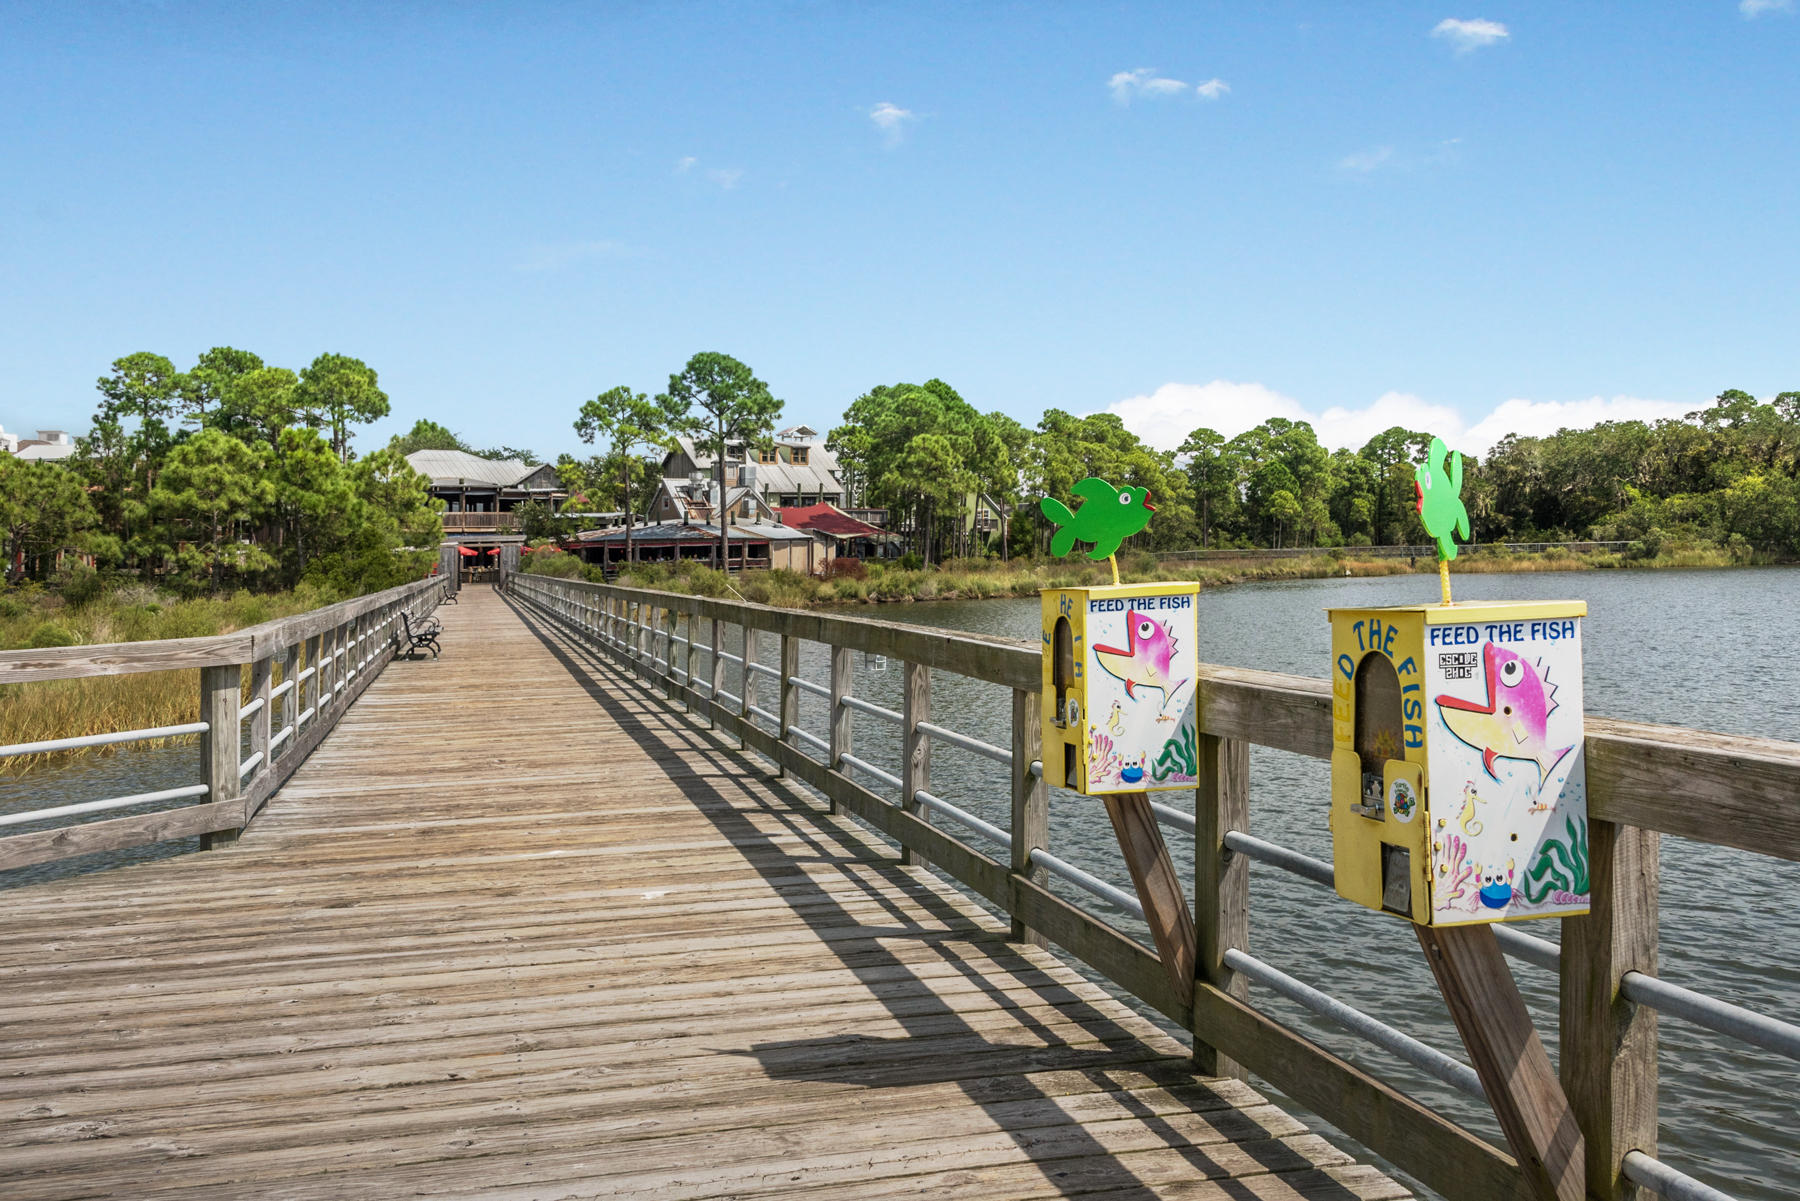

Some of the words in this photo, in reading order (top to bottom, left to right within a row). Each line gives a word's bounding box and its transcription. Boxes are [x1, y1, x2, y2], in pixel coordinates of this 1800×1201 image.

[1090, 599, 1124, 612] FEED
[1128, 598, 1155, 610] THE
[1160, 597, 1190, 609] FISH
[1431, 626, 1479, 646] FEED
[1485, 624, 1524, 642] THE
[1532, 621, 1574, 640] FISH
[1353, 619, 1398, 658] THE
[1398, 657, 1423, 748] FISH
